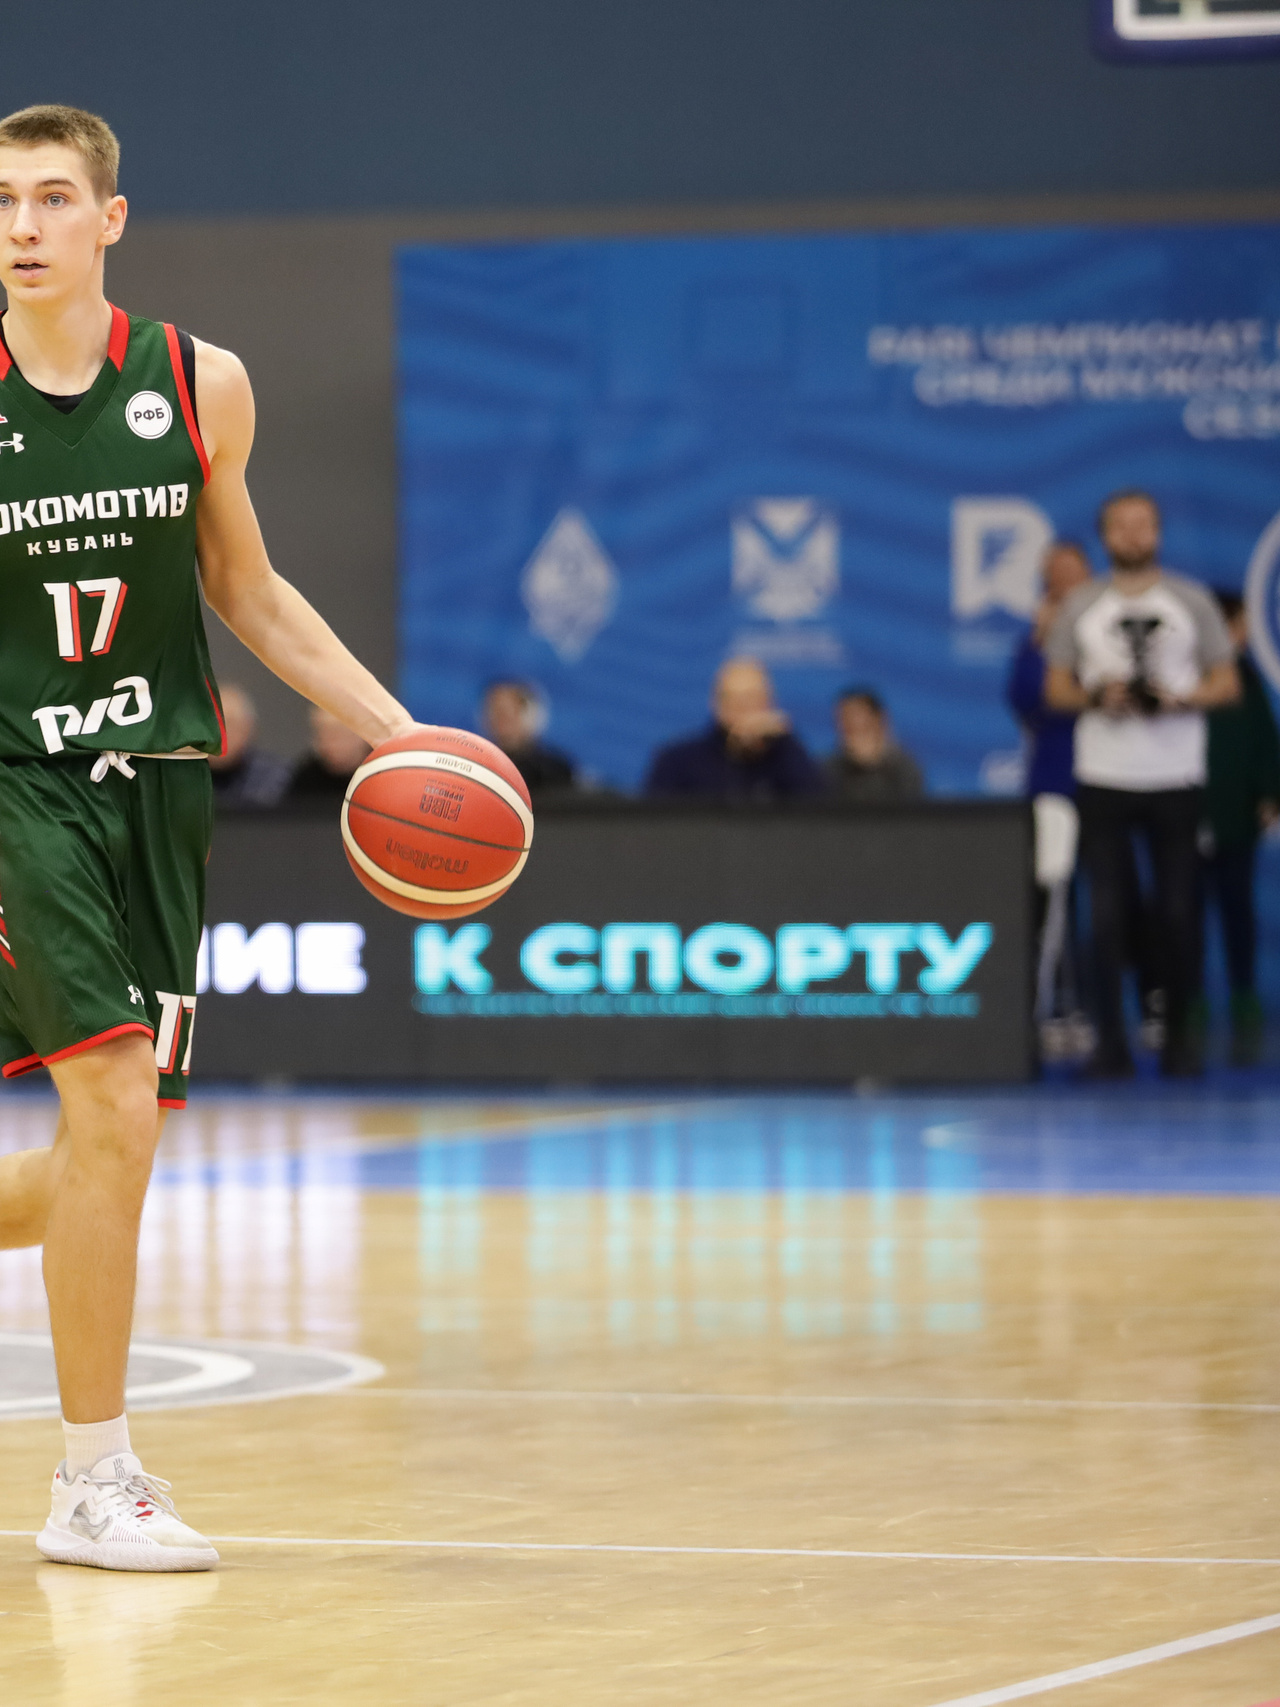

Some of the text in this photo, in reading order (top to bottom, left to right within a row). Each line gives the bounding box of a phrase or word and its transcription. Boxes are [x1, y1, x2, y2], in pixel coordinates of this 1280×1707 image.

[134, 407, 165, 423] РФБ
[26, 532, 134, 556] КУБАНЬ
[42, 577, 128, 662] 17
[419, 794, 462, 822] FIBA
[386, 837, 470, 875] molten
[414, 921, 492, 995] К
[520, 921, 994, 995] СПОРТУ
